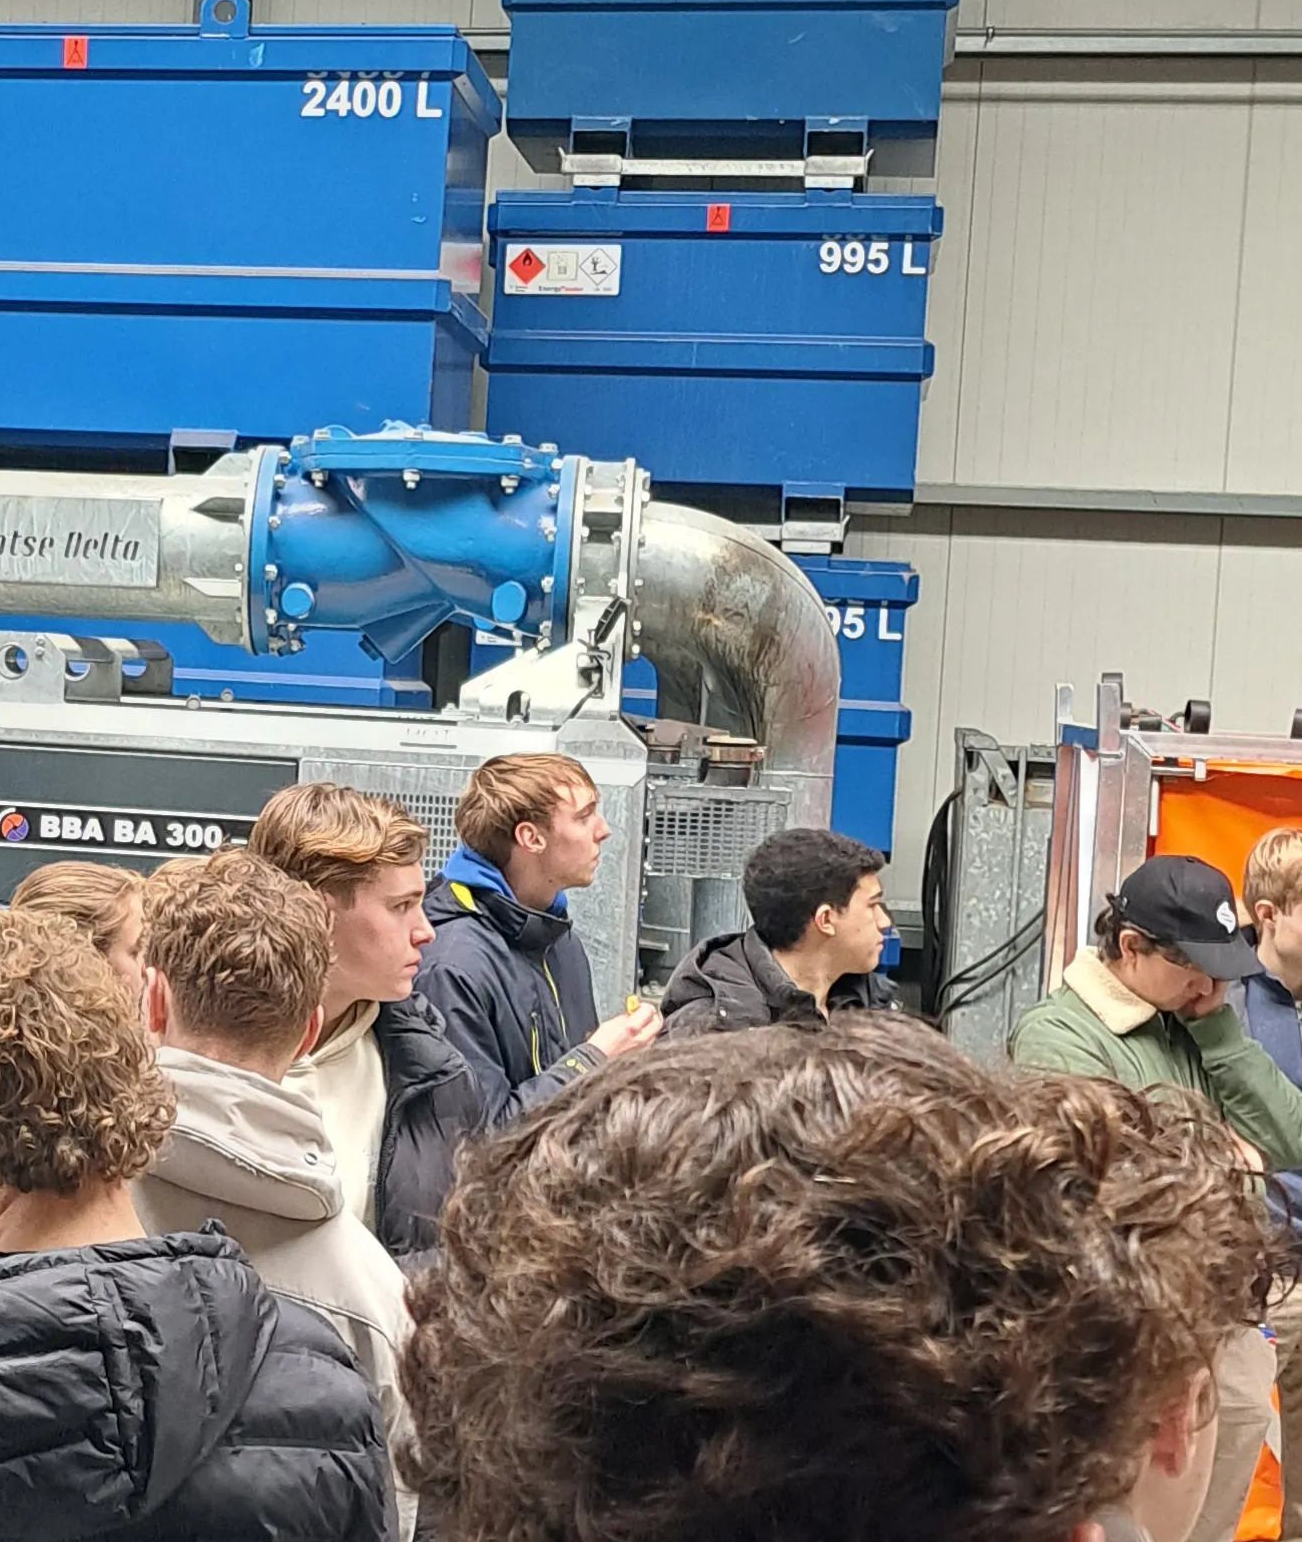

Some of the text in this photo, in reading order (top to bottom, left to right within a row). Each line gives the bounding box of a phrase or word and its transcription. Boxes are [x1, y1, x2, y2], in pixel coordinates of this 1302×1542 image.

[300, 81, 443, 118] 2400 L
[819, 241, 926, 274] 995 L
[63, 531, 140, 561] Delta
[824, 606, 902, 640] 95 L
[40, 815, 104, 842] BBA
[114, 820, 157, 845] BA
[166, 823, 223, 848] 300
